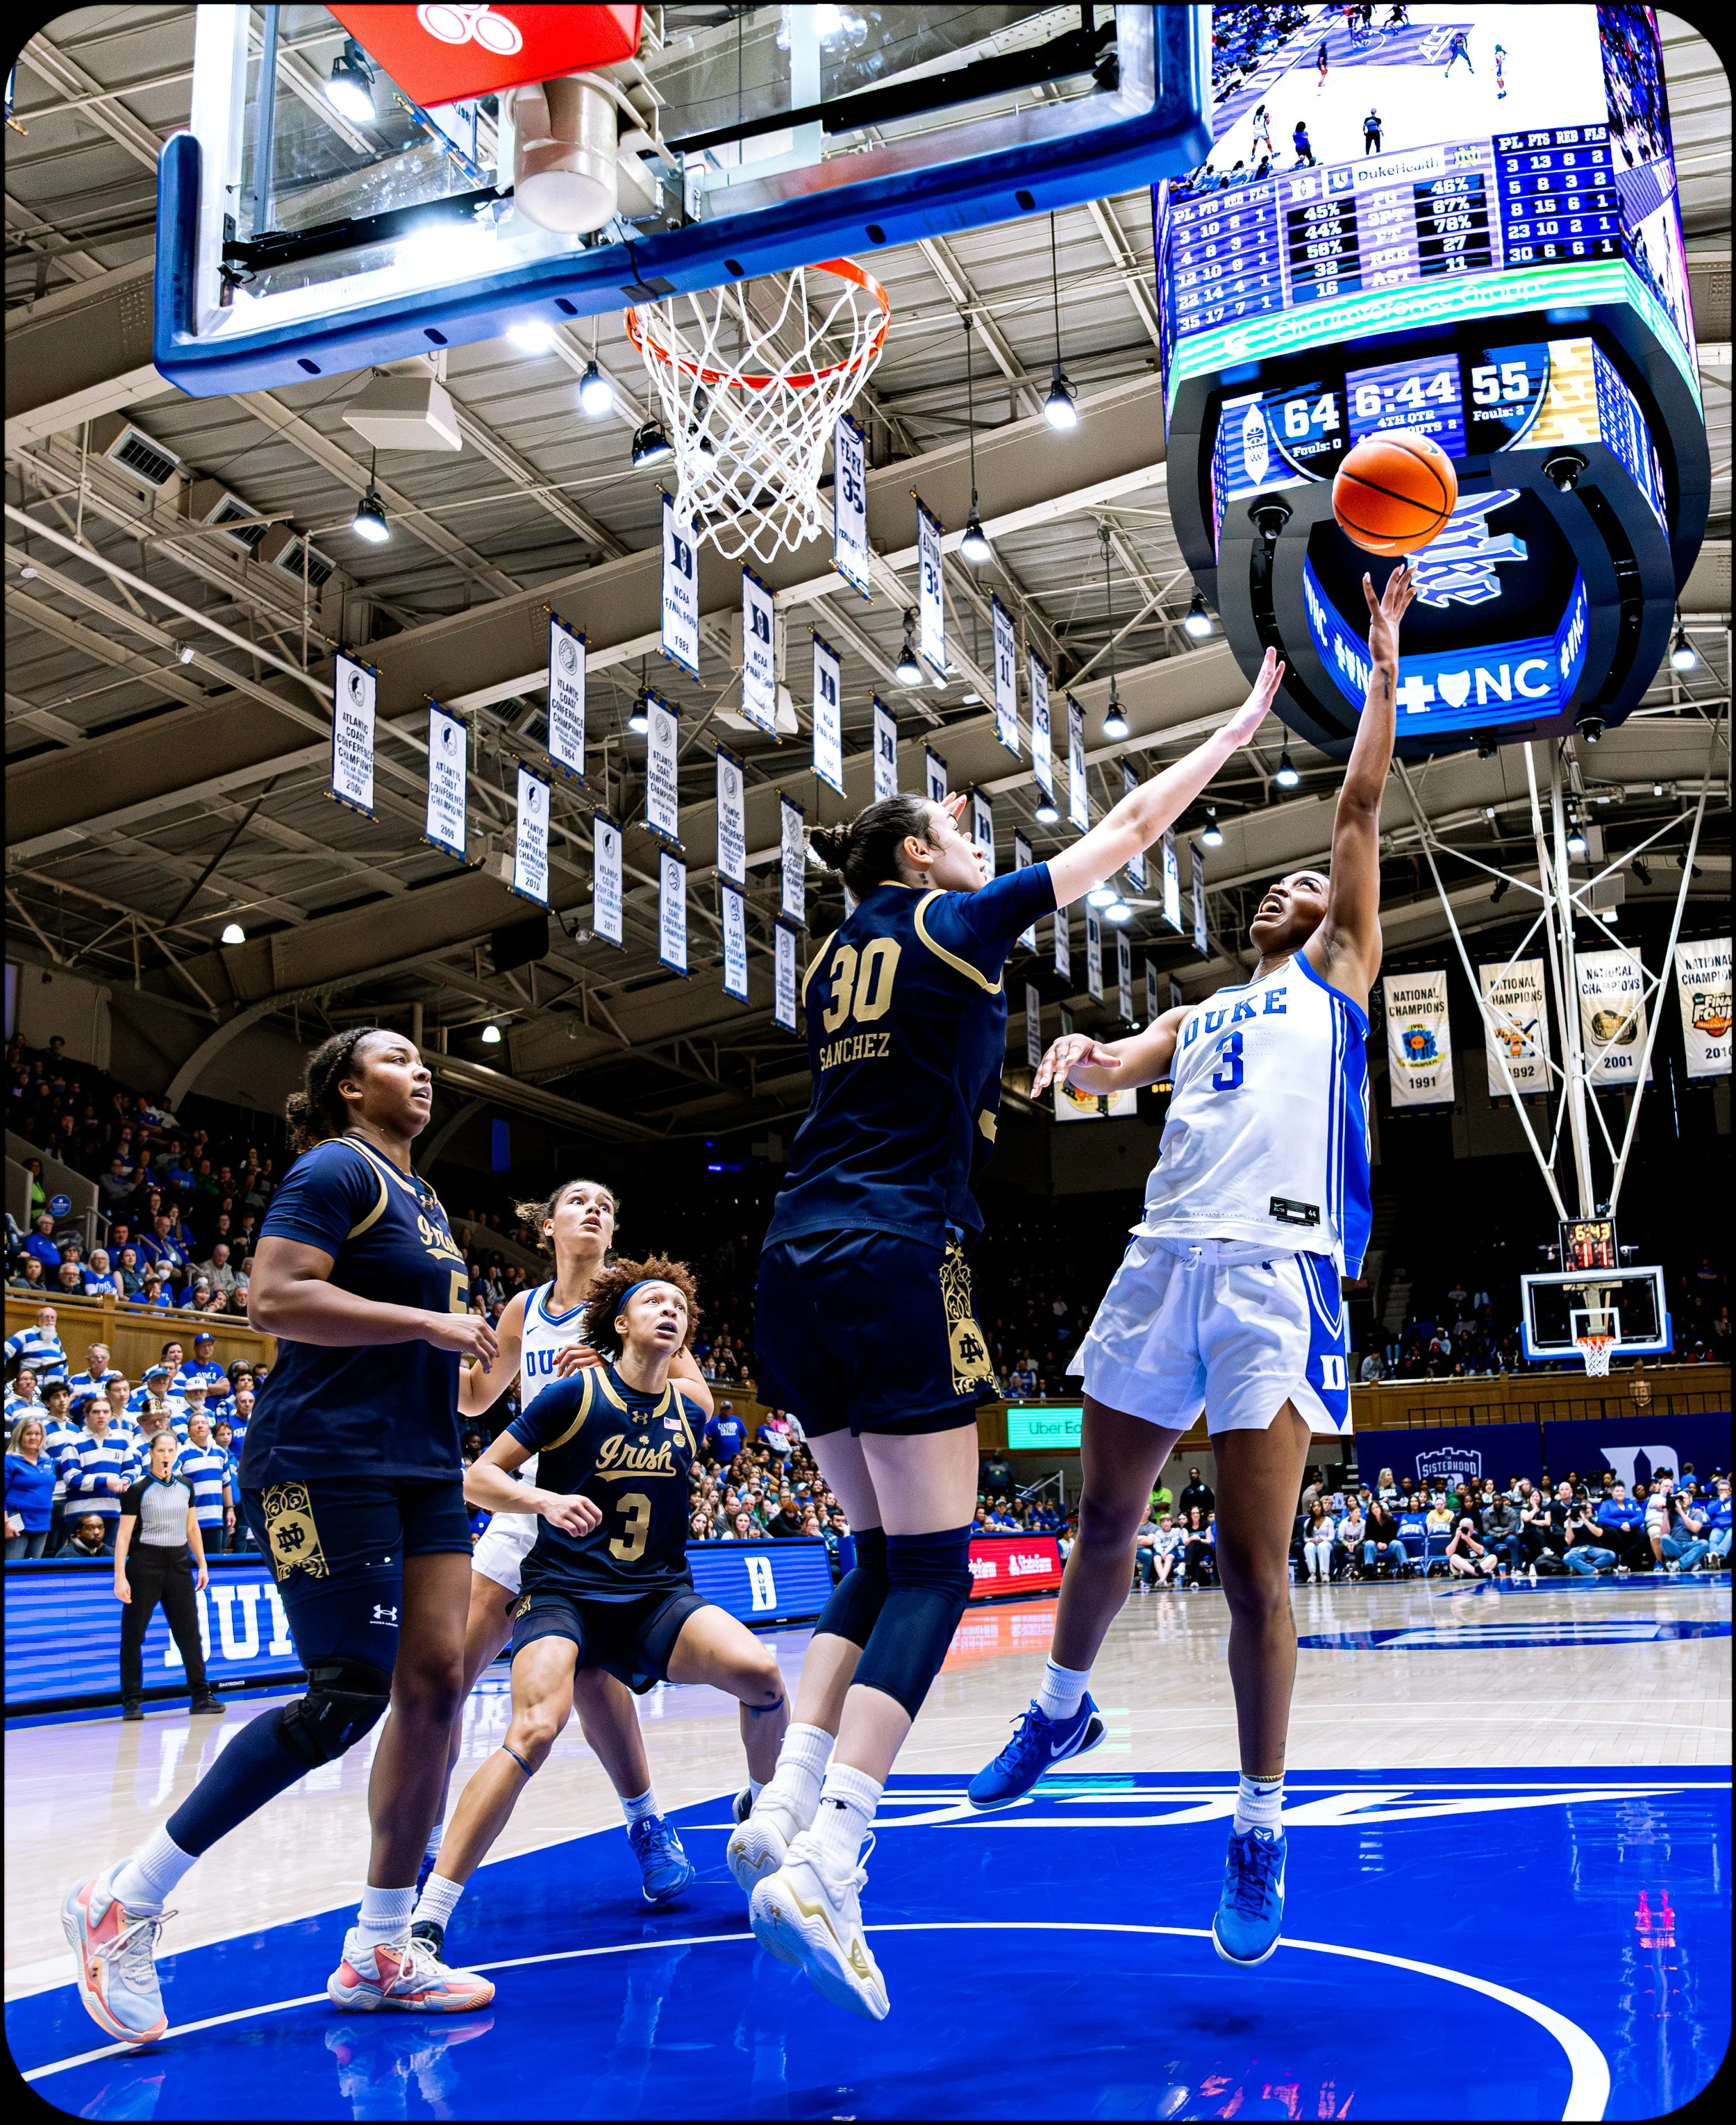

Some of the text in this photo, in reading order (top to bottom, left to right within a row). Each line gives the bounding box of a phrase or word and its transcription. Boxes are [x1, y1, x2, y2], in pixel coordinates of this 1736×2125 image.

[1499, 126, 1606, 150] PL PTS REB FLS
[1358, 158, 1439, 181] DukeHealth
[1507, 150, 1603, 172] 3 13 8 2
[1509, 172, 1606, 194] 5 8 3 2
[1174, 209, 1195, 225] PL
[1224, 193, 1243, 209] REB
[1249, 185, 1270, 201] FLS
[1303, 201, 1340, 219] 45%
[1430, 176, 1469, 194] 46%
[1511, 194, 1608, 216] 8 15 6 1
[1180, 209, 1266, 244] 3 10 2 1
[1305, 196, 1469, 239] 44% 3PT 67%
[1508, 217, 1610, 238] 23 10 2 1
[1180, 230, 1267, 265] 4 8 3 1
[1306, 214, 1472, 258] 56% FT 78%
[1314, 235, 1466, 277] 32 REB 27
[1510, 239, 1613, 260] 30 6 6 1
[1178, 272, 1196, 290] 12
[1203, 265, 1222, 281] 10
[1258, 252, 1269, 265] 1
[1316, 256, 1468, 299] 16 AST 11
[1179, 274, 1270, 309] 22 14 4 1
[1460, 283, 1541, 306] Group
[1180, 295, 1272, 331] 35 17 7 1
[1355, 372, 1455, 417] 6:44
[1471, 362, 1529, 404] 55
[1284, 392, 1339, 438] 64
[1377, 410, 1435, 428] 4TH QTR
[1448, 419, 1457, 429] 2
[1473, 405, 1525, 422] Fouls: 2
[1293, 439, 1342, 457] Fouls: 0
[842, 466, 865, 515] 35
[674, 585, 689, 606] NCAA
[665, 597, 683, 618] FINAL
[753, 651, 767, 669] NCAA
[1001, 654, 1010, 688] 11
[558, 678, 578, 701] ATLANTIC
[1474, 658, 1551, 705] NC
[560, 692, 576, 710] COAST
[343, 712, 368, 735] ATLANTIC
[552, 699, 583, 728] CONFERENCE
[347, 726, 365, 744] COAST
[553, 712, 582, 740] CHAMPIONS
[817, 724, 828, 740] FINAL
[337, 733, 374, 762] CONFERENCE
[338, 747, 372, 774] CHAMPIONS
[436, 761, 460, 782] ATLANTIC
[653, 751, 673, 770] ATLANTIC
[656, 764, 670, 779] COAST
[431, 782, 464, 808] CONFERENCE
[441, 775, 457, 792] COAST
[651, 783, 676, 806] CHAMPIONS
[431, 795, 462, 819] CHAMPIONS
[441, 824, 454, 839] 2009
[523, 818, 544, 838] ATLANTIC
[518, 838, 547, 861] CONFERENCE
[526, 877, 540, 891] 2010
[1587, 965, 1634, 980] NATIONAL
[823, 937, 902, 1033] 30
[1393, 987, 1439, 1003] NATIONAL
[1583, 979, 1639, 994] CHAMPIONS
[1389, 1001, 1445, 1017] CHAMPIONS
[1490, 990, 1543, 1006] HAMPIONS
[1183, 987, 1287, 1051] DUKE
[819, 1033, 891, 1072] SANCHEZ
[1212, 1031, 1244, 1092] 3
[1604, 1056, 1632, 1068] 2001
[1409, 1077, 1435, 1088] 1991
[1308, 1210, 1317, 1218] 44
[1575, 1223, 1611, 1241] 6:43
[1583, 1241, 1608, 1268] 11
[1320, 1355, 1346, 1390] D
[1029, 1422, 1061, 1434] Uber
[596, 1435, 677, 1474] Irish
[1422, 1461, 1476, 1477] SISTERHOOD
[608, 1493, 651, 1562] 3
[1402, 1525, 1420, 1535] DUKE
[1433, 1523, 1451, 1533] DUKE
[744, 1556, 777, 1611] D
